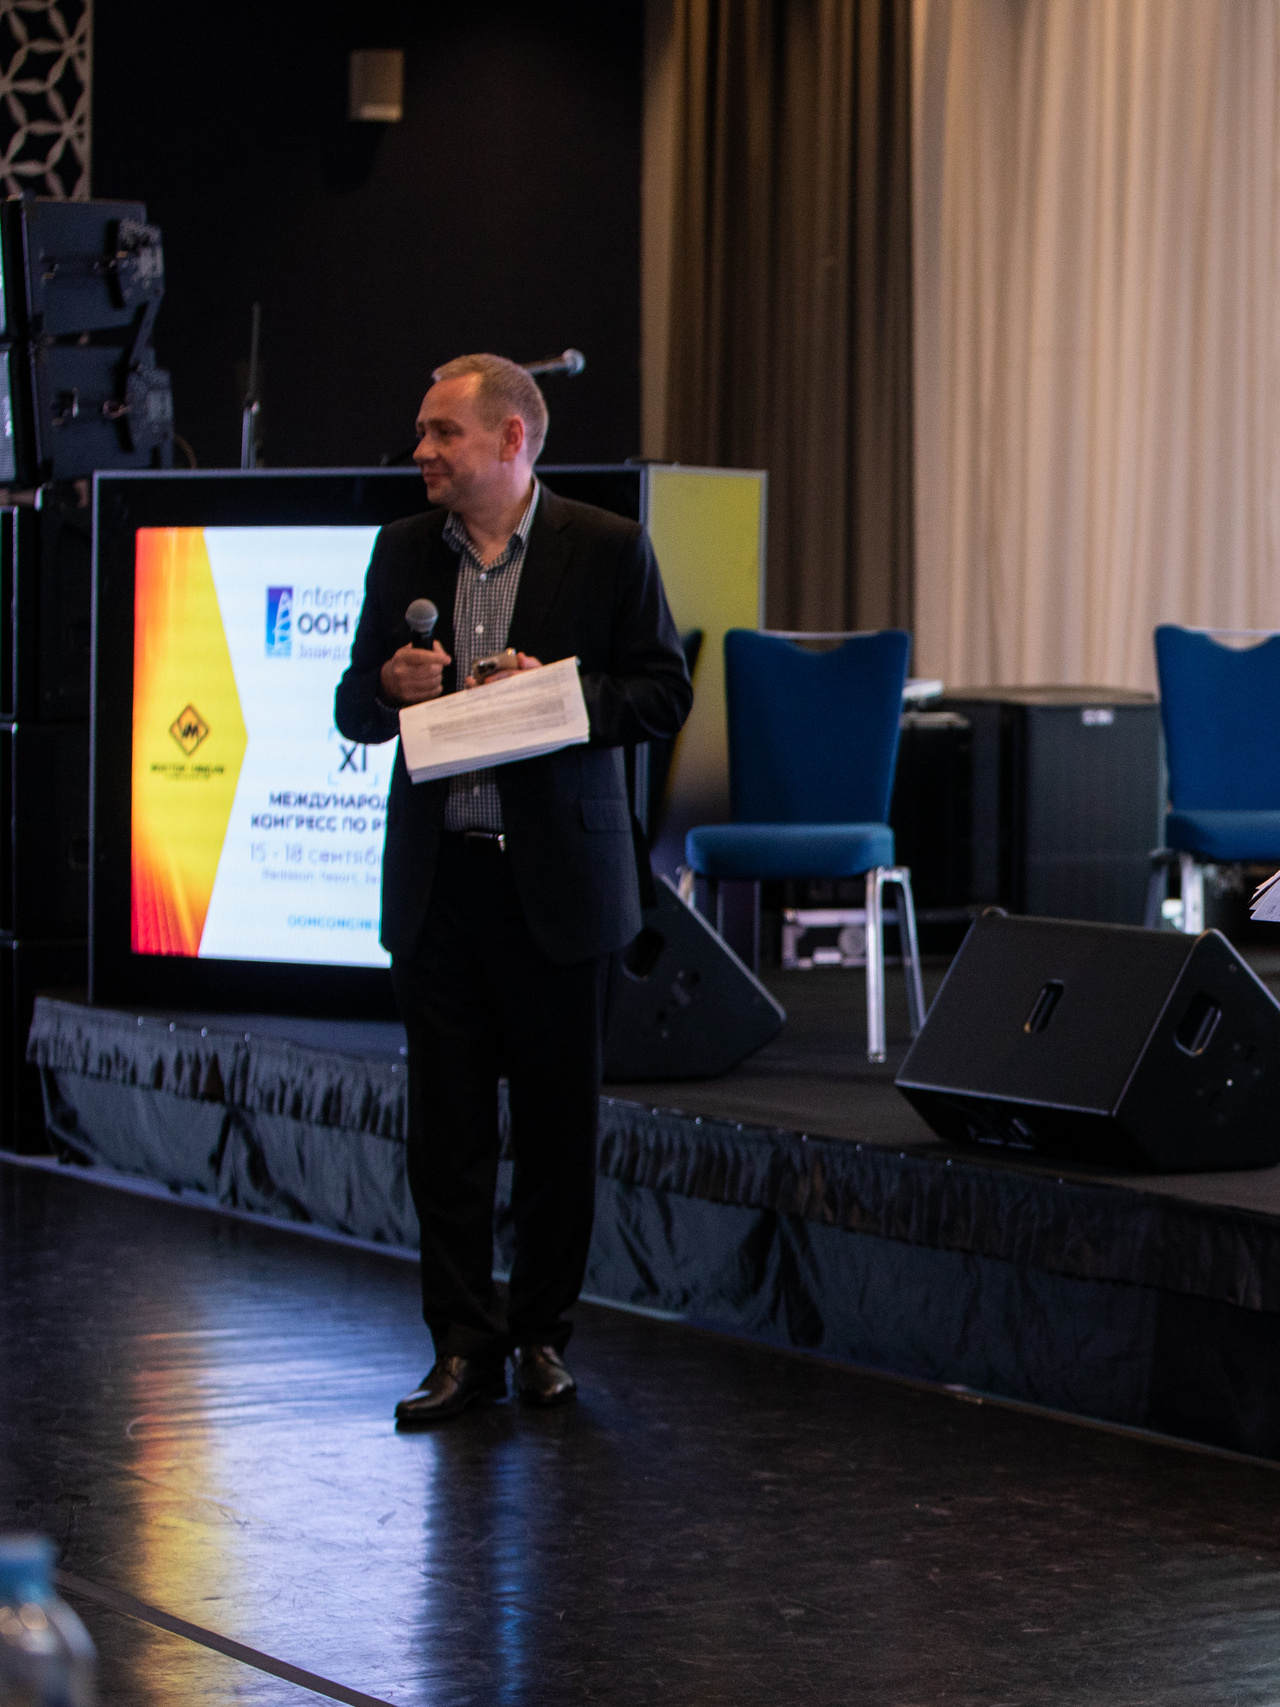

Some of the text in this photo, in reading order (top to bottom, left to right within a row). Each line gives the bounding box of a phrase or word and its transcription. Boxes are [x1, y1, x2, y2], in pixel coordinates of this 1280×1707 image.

[297, 612, 349, 635] OOH
[251, 813, 336, 832] КОНГРЕСС
[342, 816, 367, 833] ПО
